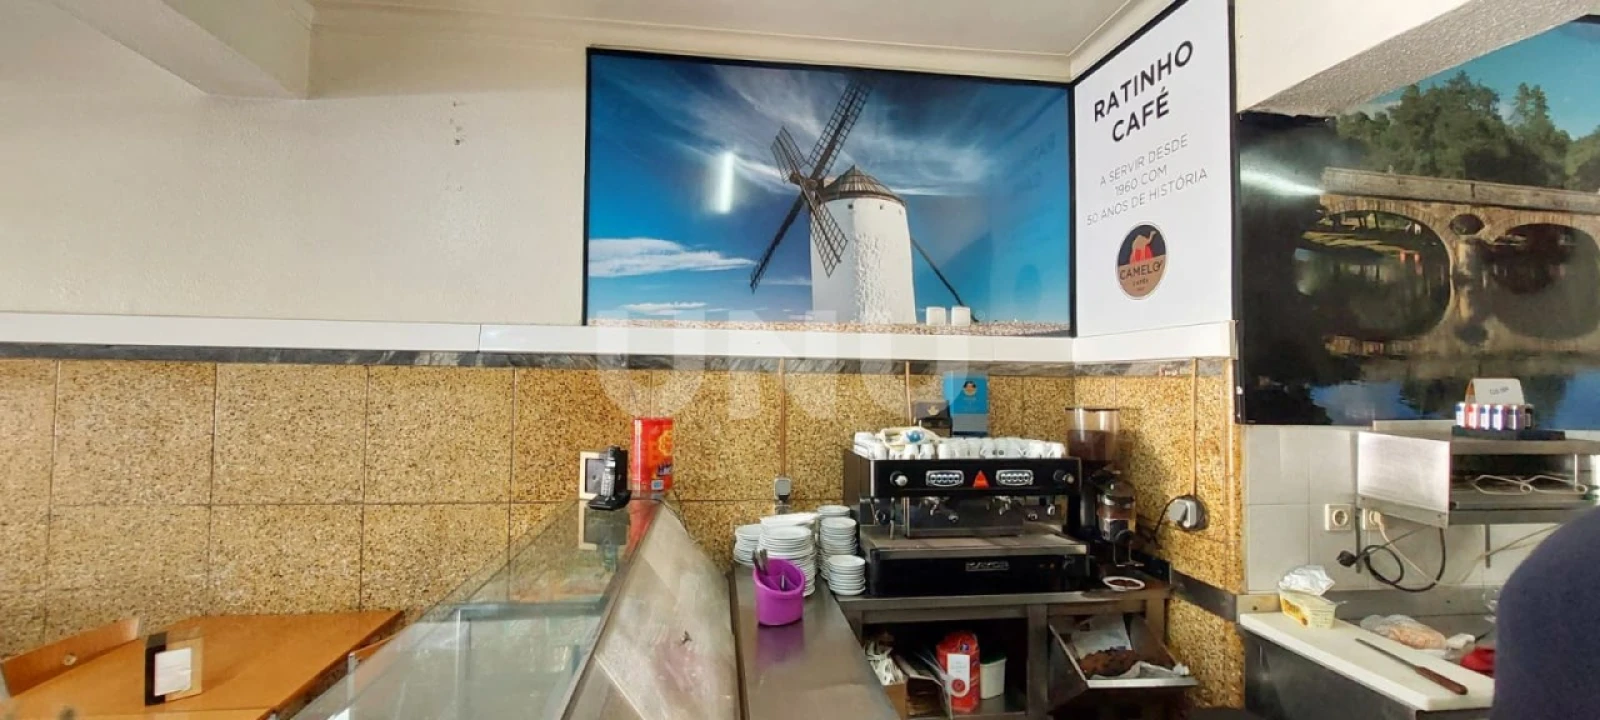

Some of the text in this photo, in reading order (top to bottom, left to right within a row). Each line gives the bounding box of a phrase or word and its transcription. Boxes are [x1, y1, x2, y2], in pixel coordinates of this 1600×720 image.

[1094, 40, 1194, 123] RATINHO
[1112, 86, 1169, 142] CAFÉ
[1100, 134, 1188, 187] A SERVIR DESDE
[1115, 164, 1167, 195] 1960 COM
[1087, 168, 1208, 225] 50 ANOS DE HISTÓRIA
[1119, 261, 1160, 281] CAMELO
